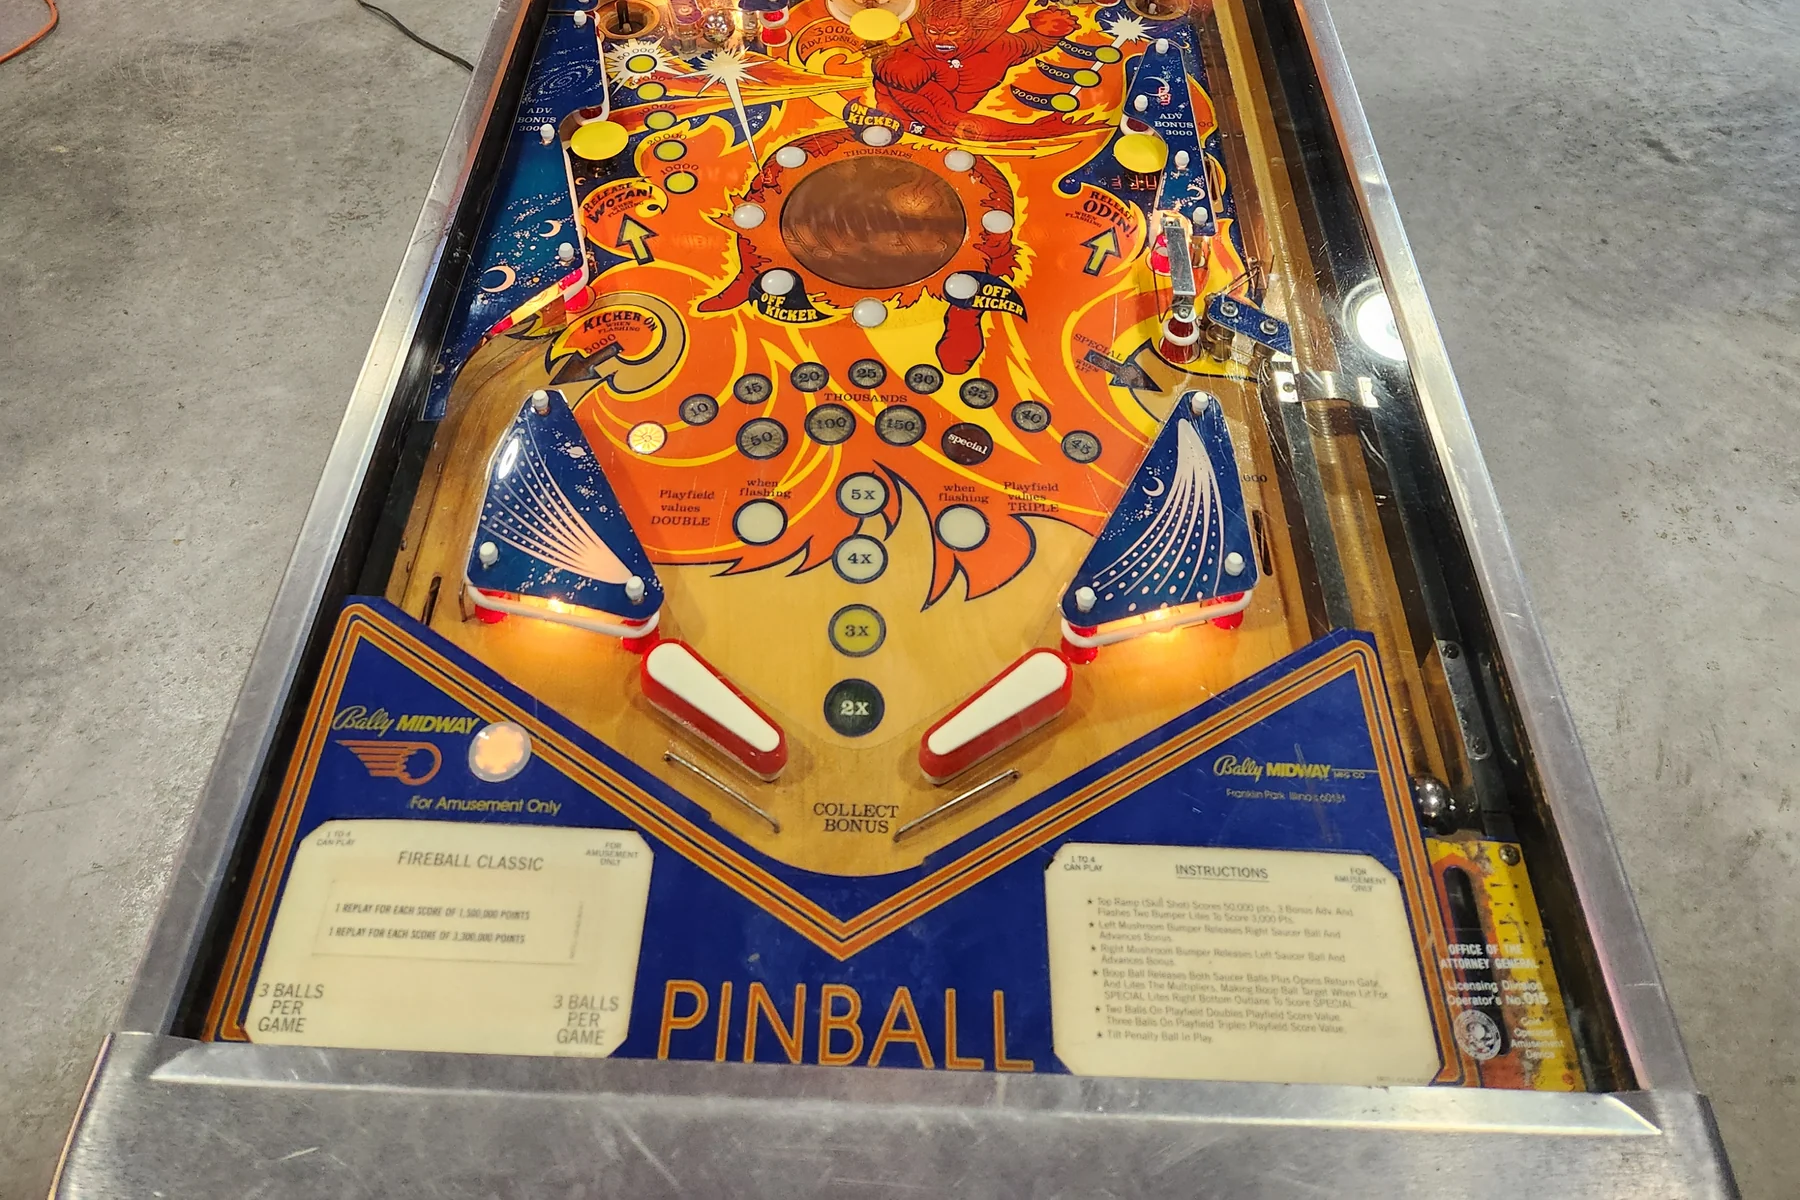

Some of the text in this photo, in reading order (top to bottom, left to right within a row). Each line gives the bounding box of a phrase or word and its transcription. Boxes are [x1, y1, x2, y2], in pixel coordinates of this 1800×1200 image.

[825, 35, 859, 47] BONUS
[1037, 61, 1070, 79] 30000
[1013, 88, 1048, 104] 30000
[850, 102, 868, 115] ON
[848, 113, 900, 132] KICKER
[843, 148, 913, 159] THOUSANDS
[583, 182, 633, 213] RELEASE
[587, 186, 653, 223] WOTAN!
[1091, 191, 1134, 221] RELEASE
[1083, 200, 1138, 238] ODIN!
[982, 284, 1011, 298] OFF
[761, 292, 786, 308] OFF
[972, 295, 1024, 316] KICKER
[765, 306, 818, 321] KICKER
[583, 311, 658, 333] KICKER ON
[584, 333, 616, 354] 5000
[1073, 333, 1123, 361] SPECIAL
[856, 368, 877, 378] 25
[1076, 359, 1099, 373] WHEN
[799, 371, 820, 382] 20
[913, 373, 935, 385] 30
[744, 382, 762, 395] 15
[967, 385, 990, 400] 35
[824, 393, 907, 403] THOUSANDS
[689, 402, 709, 416] 10
[1021, 409, 1042, 424] 40
[816, 417, 848, 430] 100
[887, 418, 916, 431] 150
[641, 432, 653, 444] 5
[750, 431, 773, 447] 50
[948, 432, 988, 455] special
[1071, 439, 1092, 455] 45
[746, 478, 778, 487] when
[943, 483, 976, 493] when
[1003, 481, 1059, 492] Playfield
[659, 489, 715, 500] Playfield
[739, 487, 792, 499] flashing
[939, 492, 989, 504] flashing
[1008, 492, 1047, 501] values
[661, 504, 700, 513] values
[1008, 503, 1059, 513] TRIPLE
[651, 516, 711, 526] DOUBLE
[840, 700, 870, 716] 2X
[332, 705, 480, 738] Bally MIDWAY
[1213, 755, 1332, 783] Bally MIDWAY
[409, 795, 562, 816] For Amusement Only
[813, 802, 899, 818] COLLECT
[823, 818, 889, 834] BONUS
[397, 851, 544, 872] FIREBALL CLASSIC
[585, 849, 639, 859] AMUSEMENT
[1083, 864, 1102, 872] PLAY
[1175, 864, 1268, 879] INSTRUCTIONS
[343, 903, 373, 914] REPLAY
[375, 904, 391, 914] FOR
[393, 904, 414, 915] EACH
[416, 906, 441, 917] SCORE
[445, 907, 456, 917] OF
[499, 909, 530, 920] POINTS
[335, 927, 366, 937] REPLAY
[368, 928, 385, 938] FOR
[387, 928, 409, 938] EACH
[411, 929, 436, 940] SCORE
[439, 931, 450, 940] OF
[495, 933, 526, 943] POINTS
[1448, 944, 1523, 955] OFFICE OF THE
[1440, 958, 1539, 969] ATTORNEY GENERAL
[259, 983, 325, 999] 3 BALLS
[1447, 980, 1498, 993] Licensing
[269, 1000, 303, 1015] PER
[553, 994, 620, 1012] 3 BALLS
[257, 1017, 307, 1034] GAME
[567, 1012, 600, 1027] PER
[657, 979, 1034, 1072] PINBALL
[556, 1029, 605, 1045] GAME
[1124, 1030, 1179, 1042] Penalty Ball
